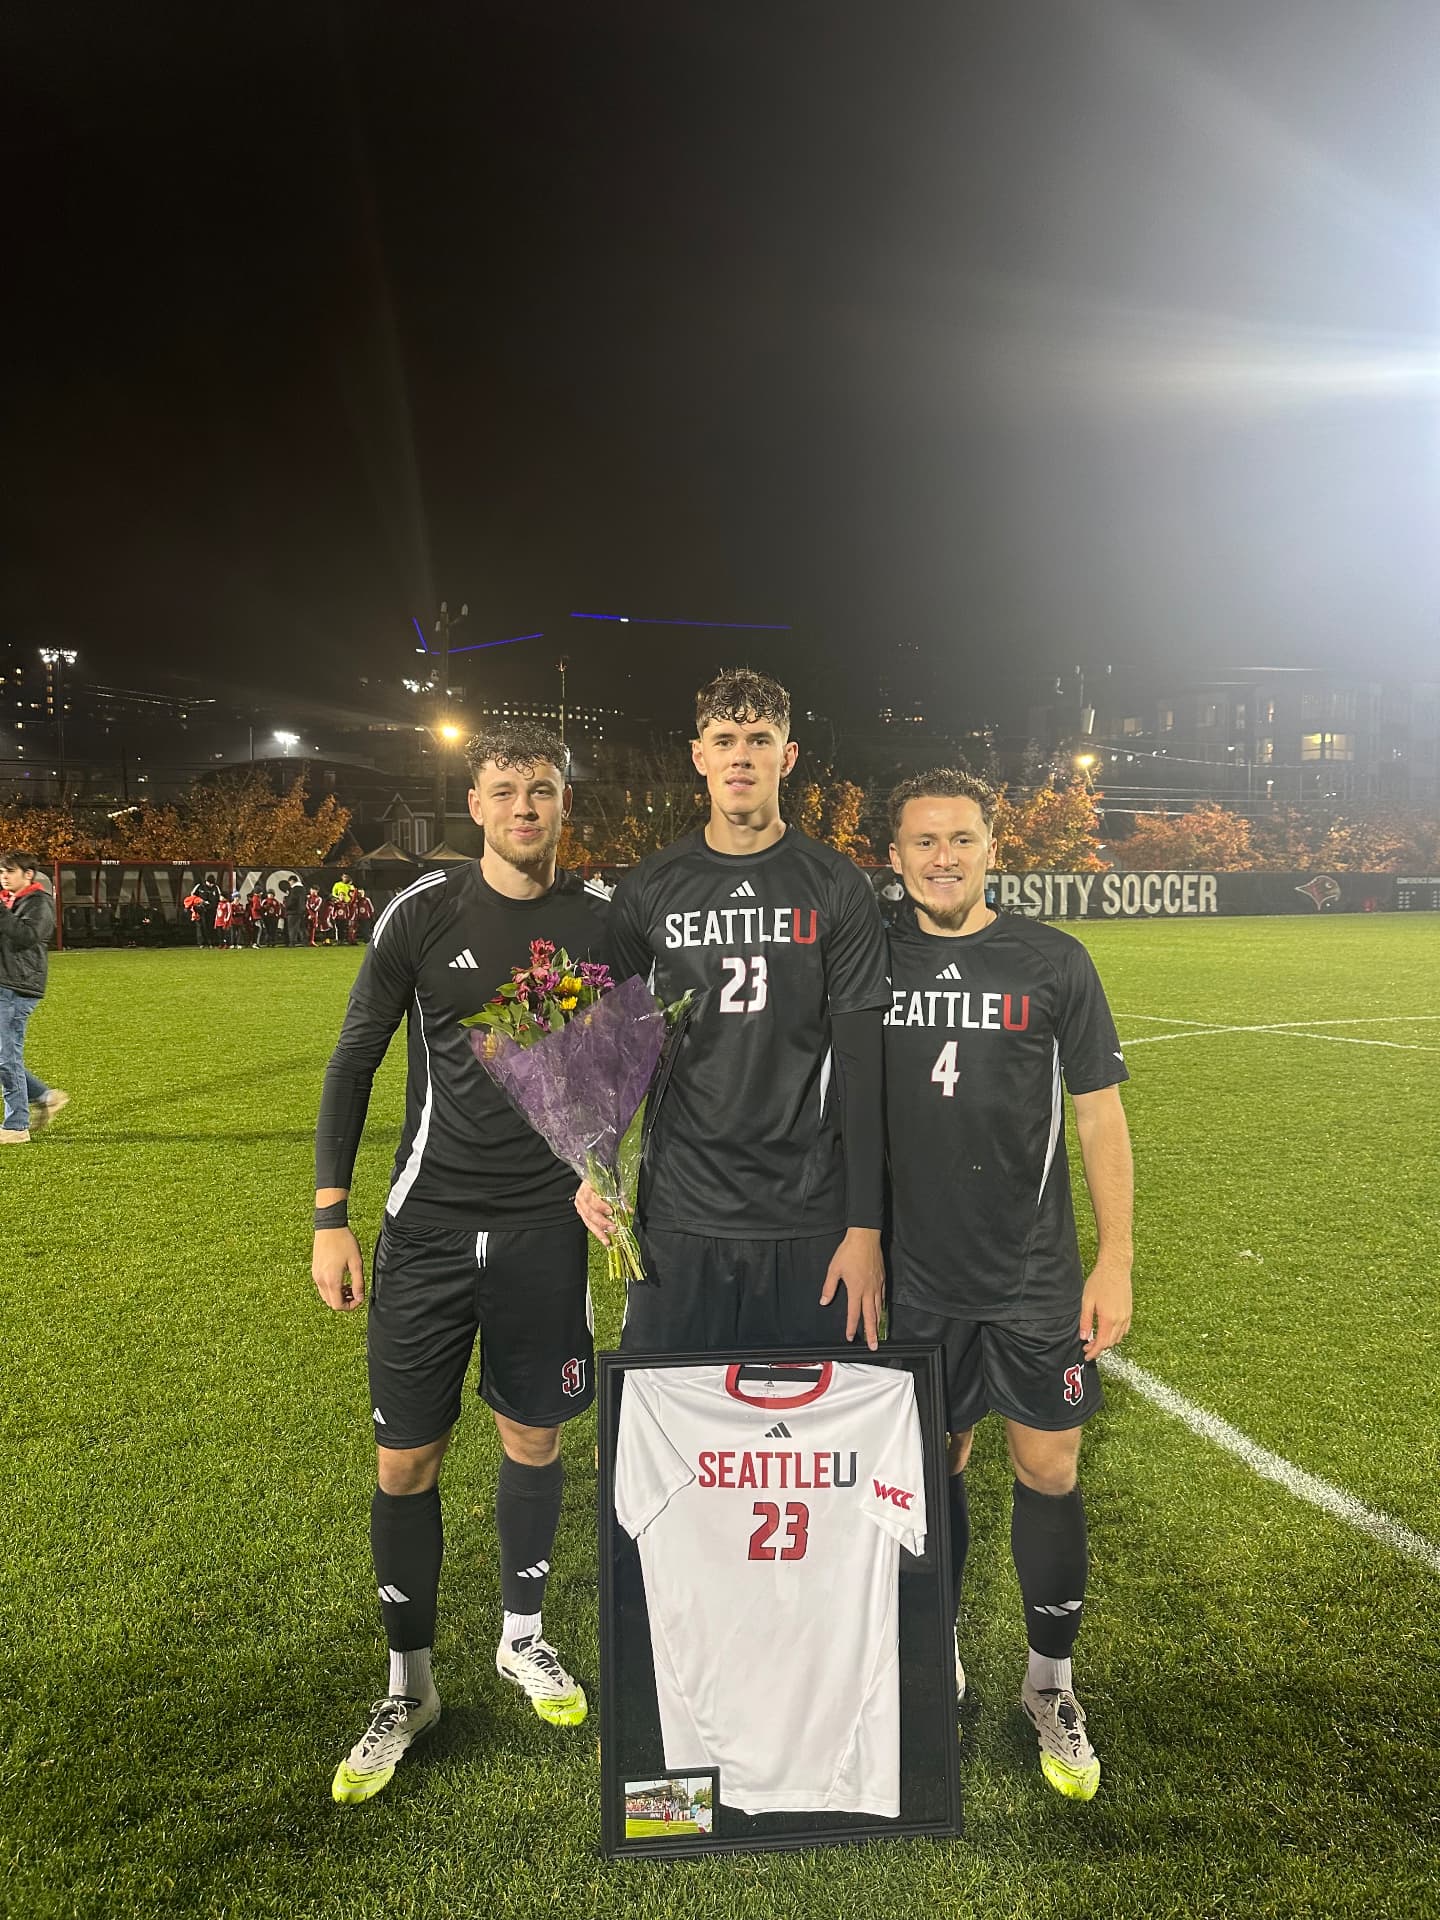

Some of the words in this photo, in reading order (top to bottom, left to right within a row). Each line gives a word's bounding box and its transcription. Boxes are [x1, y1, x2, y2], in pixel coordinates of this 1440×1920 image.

[1102, 874, 1218, 915] SOCCER
[665, 907, 818, 949] SEATTLEU
[719, 955, 768, 1013] 23
[931, 1041, 961, 1097] 4
[698, 1451, 858, 1489] SEATTLEU
[873, 1478, 915, 1510] WCC
[748, 1502, 810, 1560] 23
